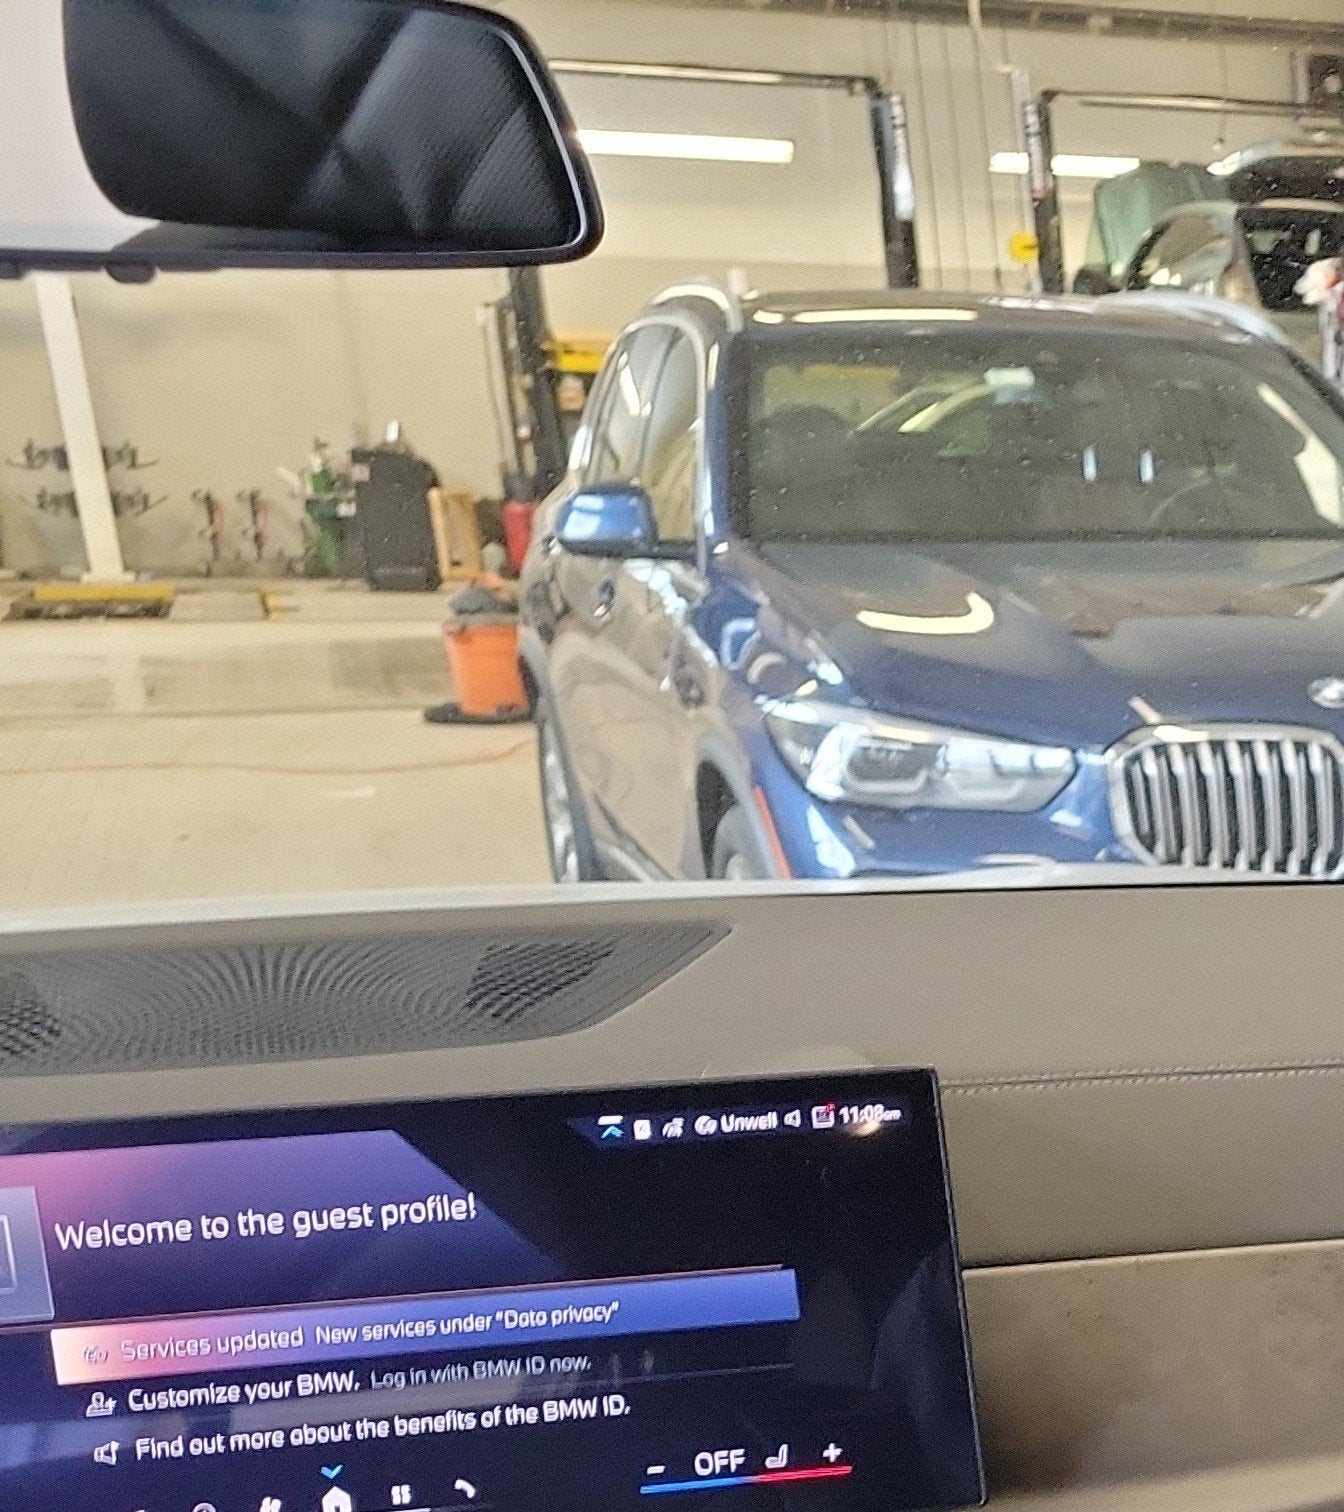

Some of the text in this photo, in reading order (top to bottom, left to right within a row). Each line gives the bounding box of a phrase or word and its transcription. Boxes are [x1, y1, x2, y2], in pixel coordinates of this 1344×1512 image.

[720, 1111, 778, 1133] Unwell
[55, 1191, 478, 1251] Welcome to the guest profile!
[120, 1336, 212, 1362] Services
[217, 1325, 304, 1357] updated
[315, 1324, 359, 1346] New
[362, 1316, 437, 1342] services
[439, 1313, 493, 1336] under
[128, 1383, 241, 1412] Customize
[244, 1379, 293, 1404] your
[371, 1370, 406, 1391] Log
[409, 1367, 427, 1385] in
[431, 1362, 469, 1384] with
[473, 1358, 522, 1380] BMW
[526, 1355, 545, 1374] ID
[135, 1435, 184, 1461] Find
[189, 1434, 225, 1456] out
[230, 1429, 285, 1451] more
[290, 1420, 352, 1447] about
[355, 1417, 389, 1439] the
[394, 1411, 477, 1437] benefits
[481, 1405, 502, 1428] of
[505, 1403, 538, 1425] the
[542, 1397, 597, 1423] BMW
[693, 1448, 746, 1478] OFF
